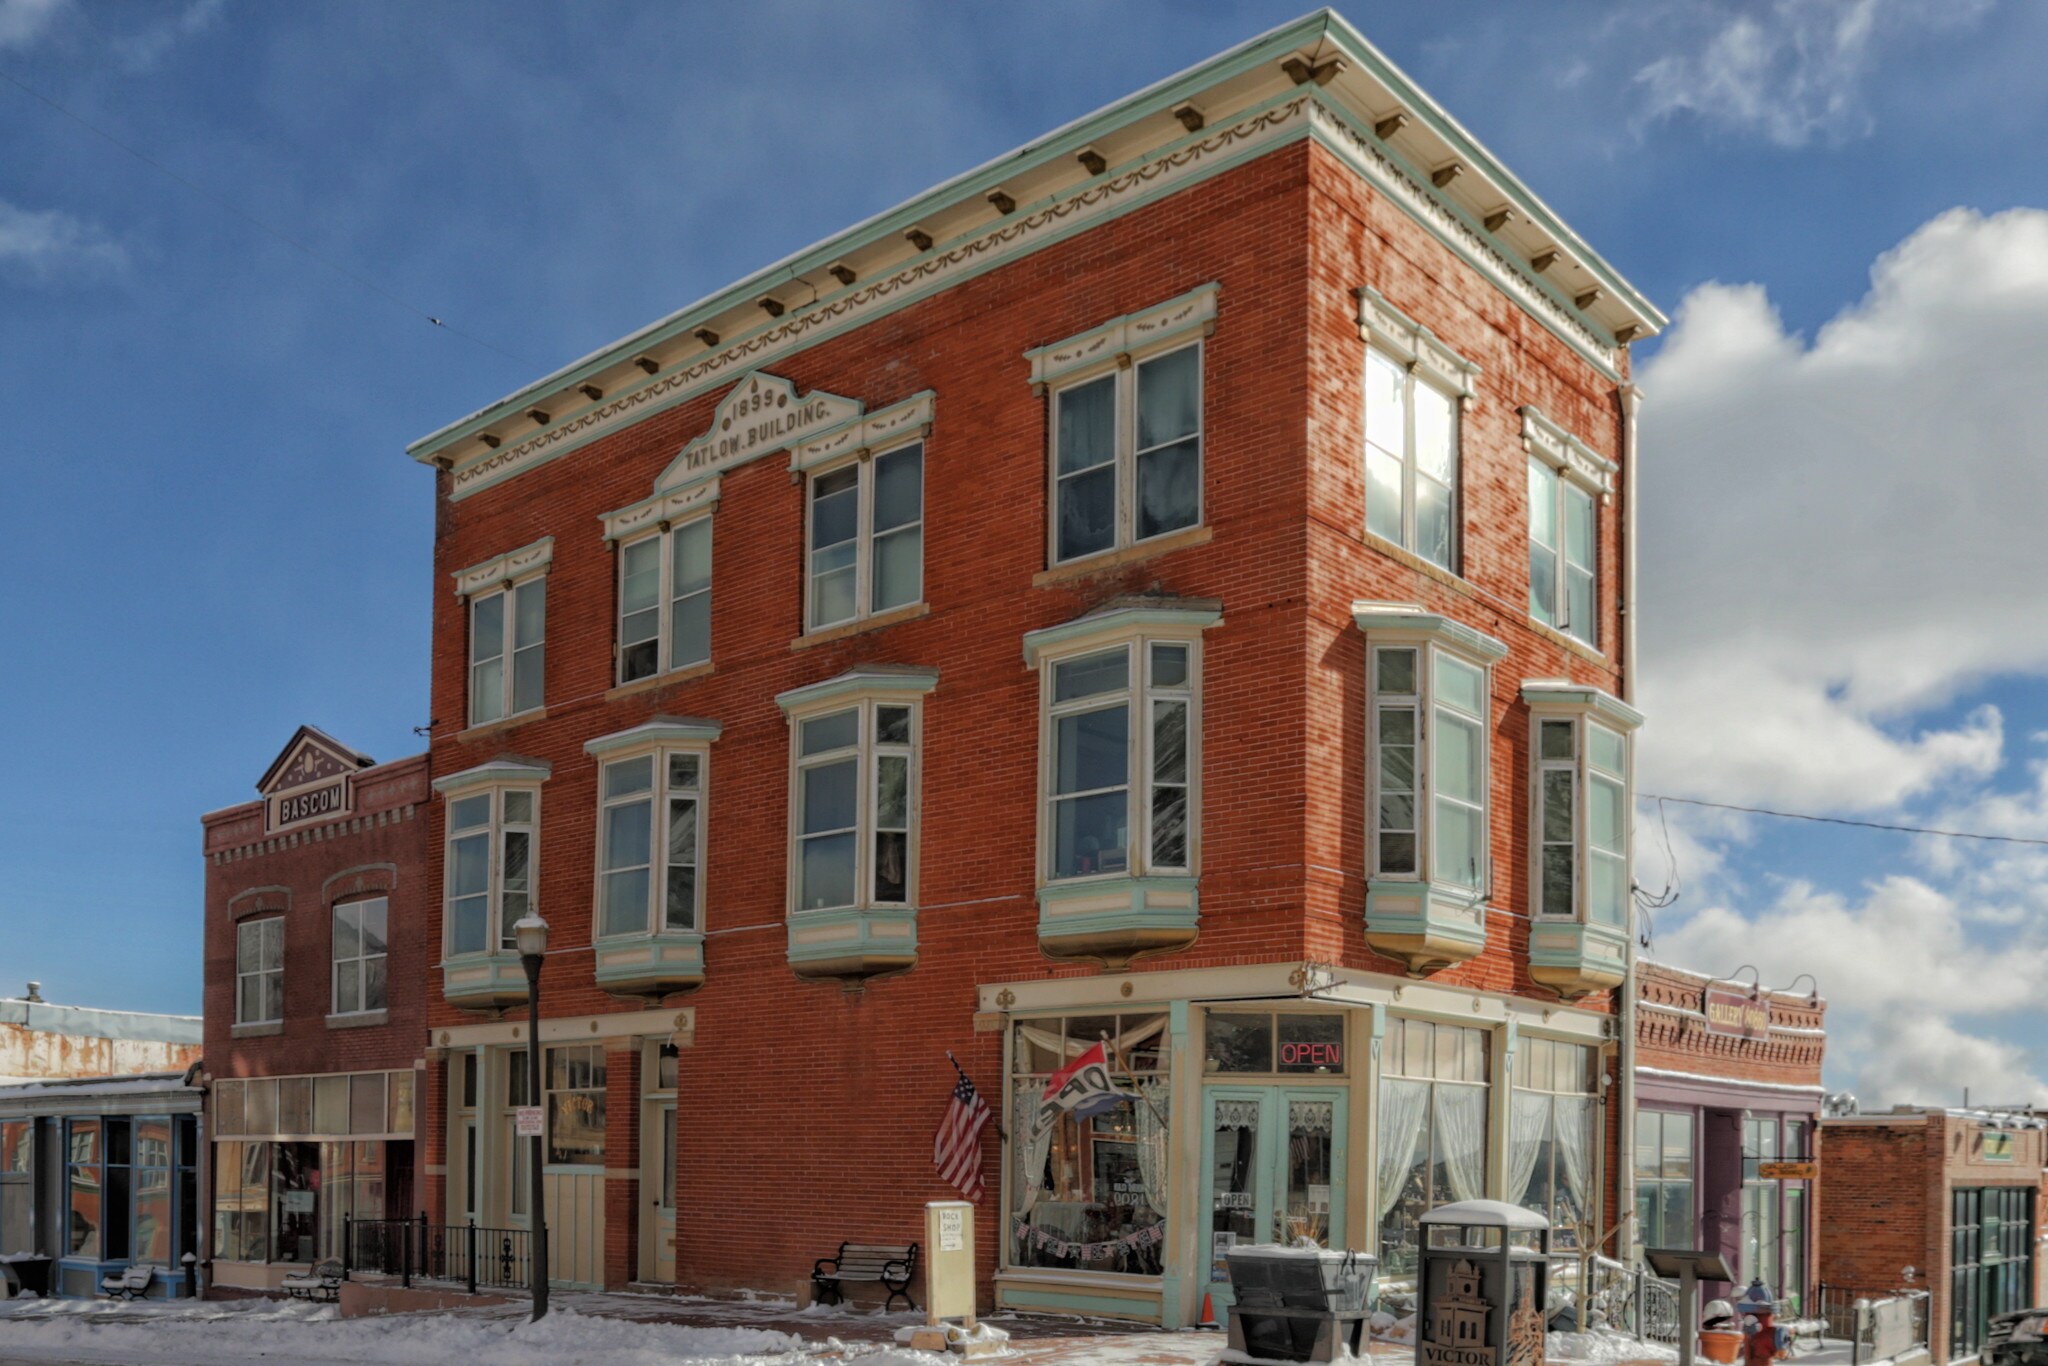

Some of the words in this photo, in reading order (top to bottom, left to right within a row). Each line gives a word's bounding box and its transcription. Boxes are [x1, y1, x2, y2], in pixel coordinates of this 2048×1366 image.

[733, 389, 773, 421] 1899
[282, 787, 339, 821] BASCOM
[1709, 1003, 1745, 1028] GALLERY
[1281, 1043, 1340, 1064] OPEN
[1223, 1194, 1250, 1206] OPEN
[1426, 1348, 1490, 1366] VICTOR
